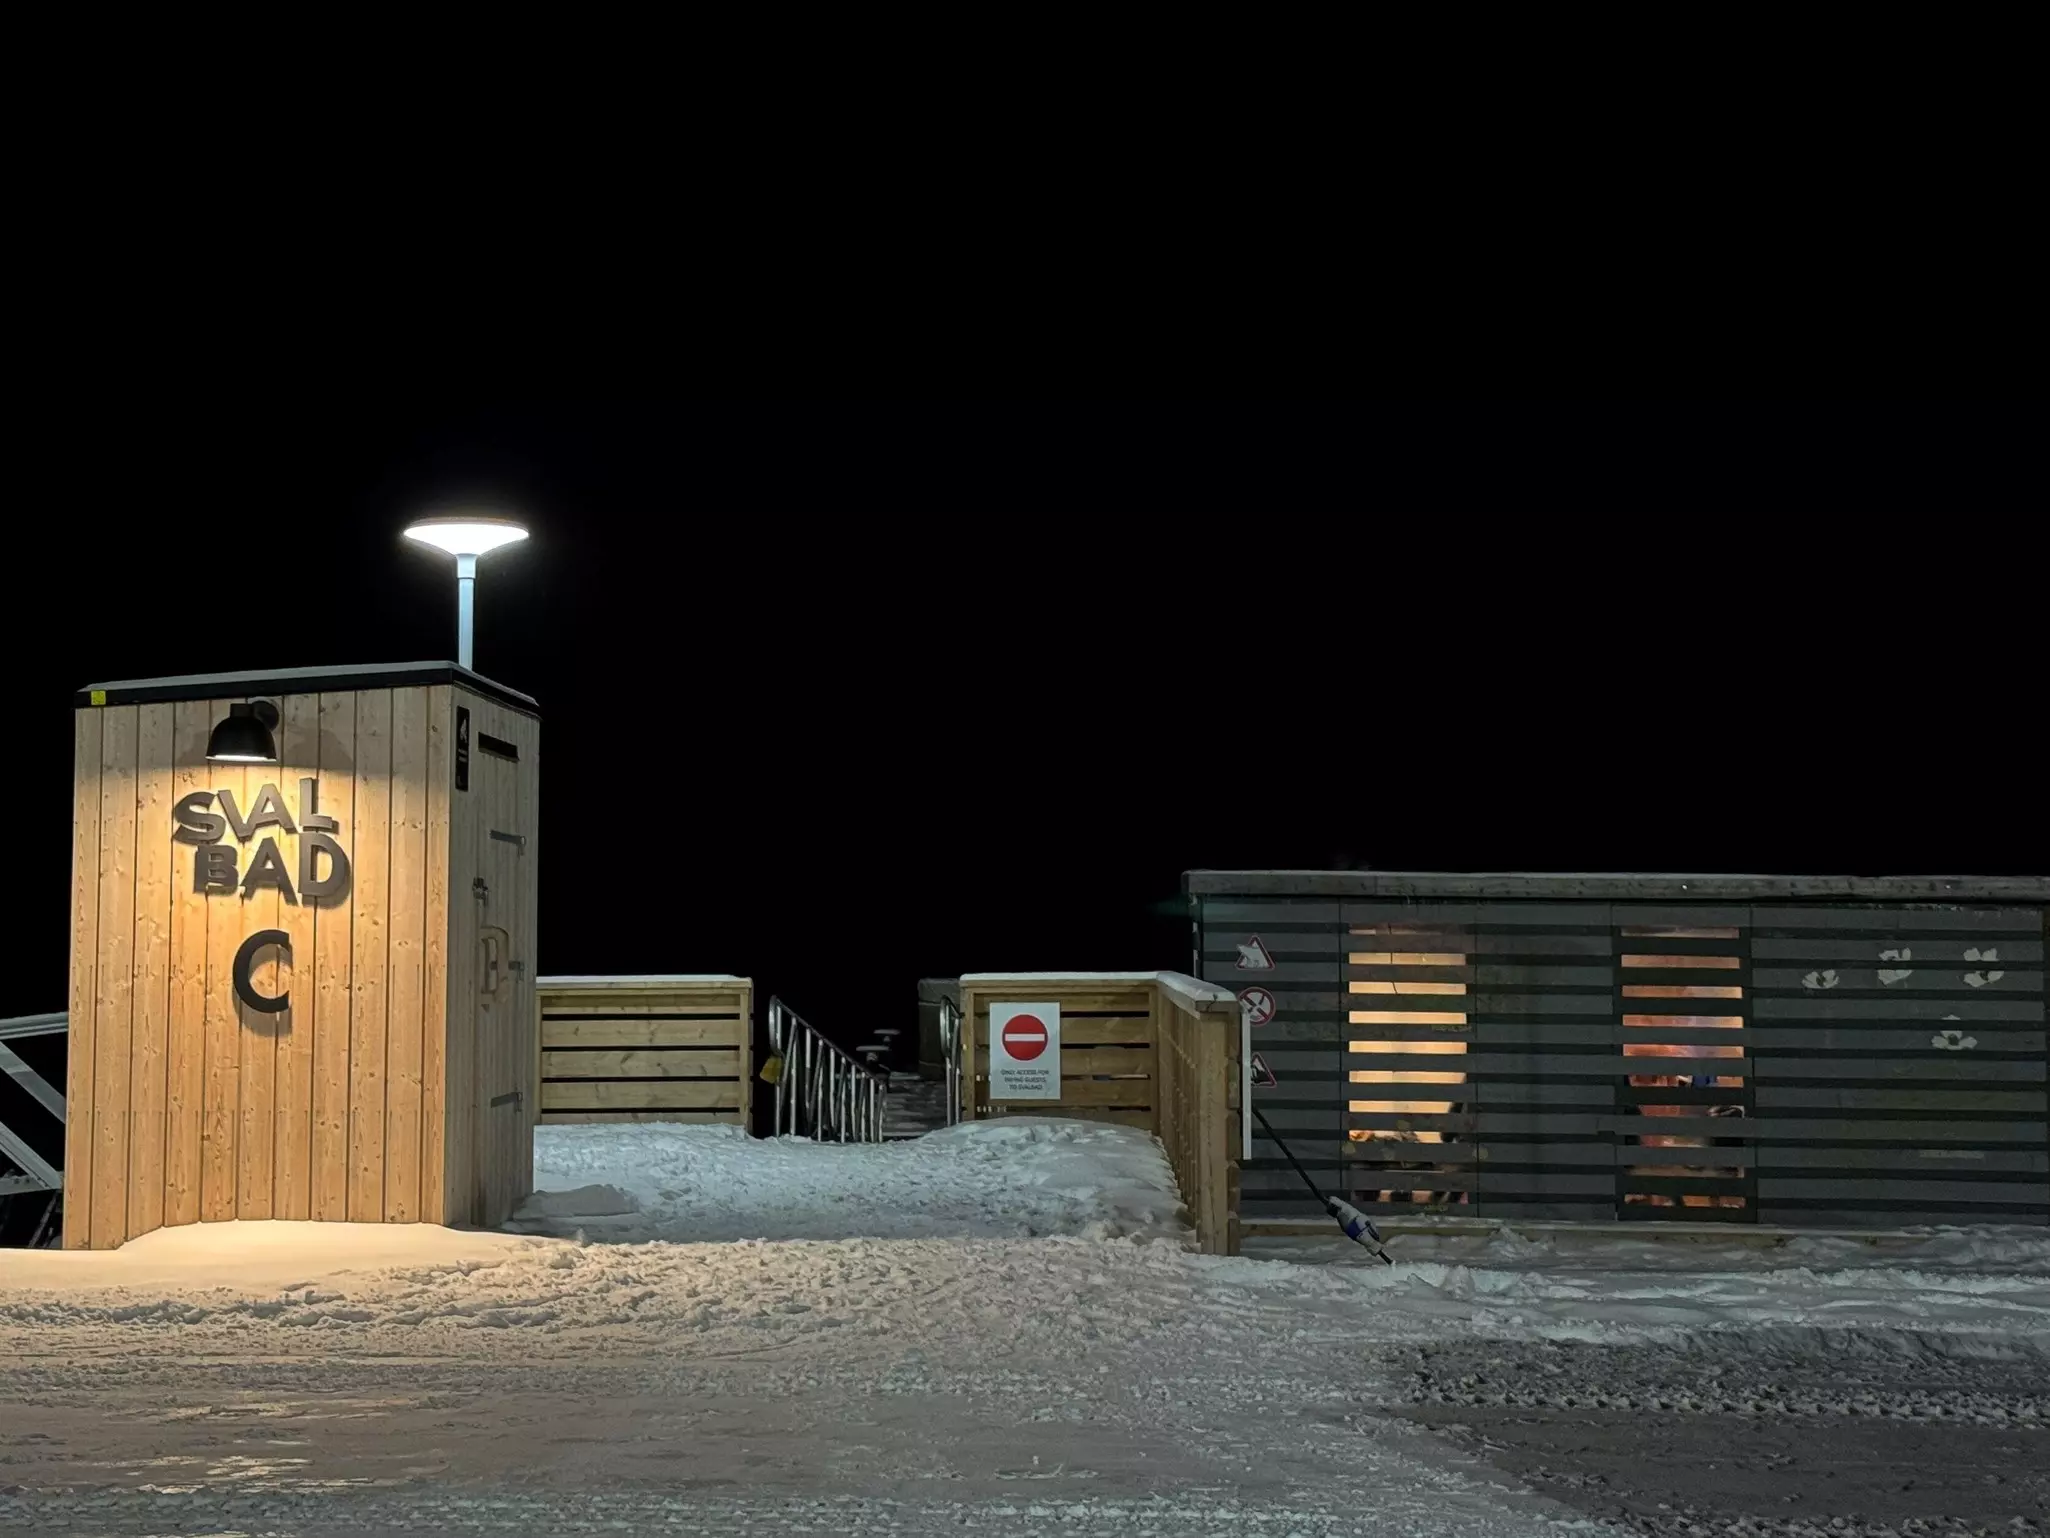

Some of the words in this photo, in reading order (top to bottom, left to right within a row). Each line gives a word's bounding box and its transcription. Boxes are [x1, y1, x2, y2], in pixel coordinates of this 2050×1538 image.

[174, 777, 334, 843] SVAL
[194, 832, 350, 905] BAD
[233, 929, 290, 1013] C
